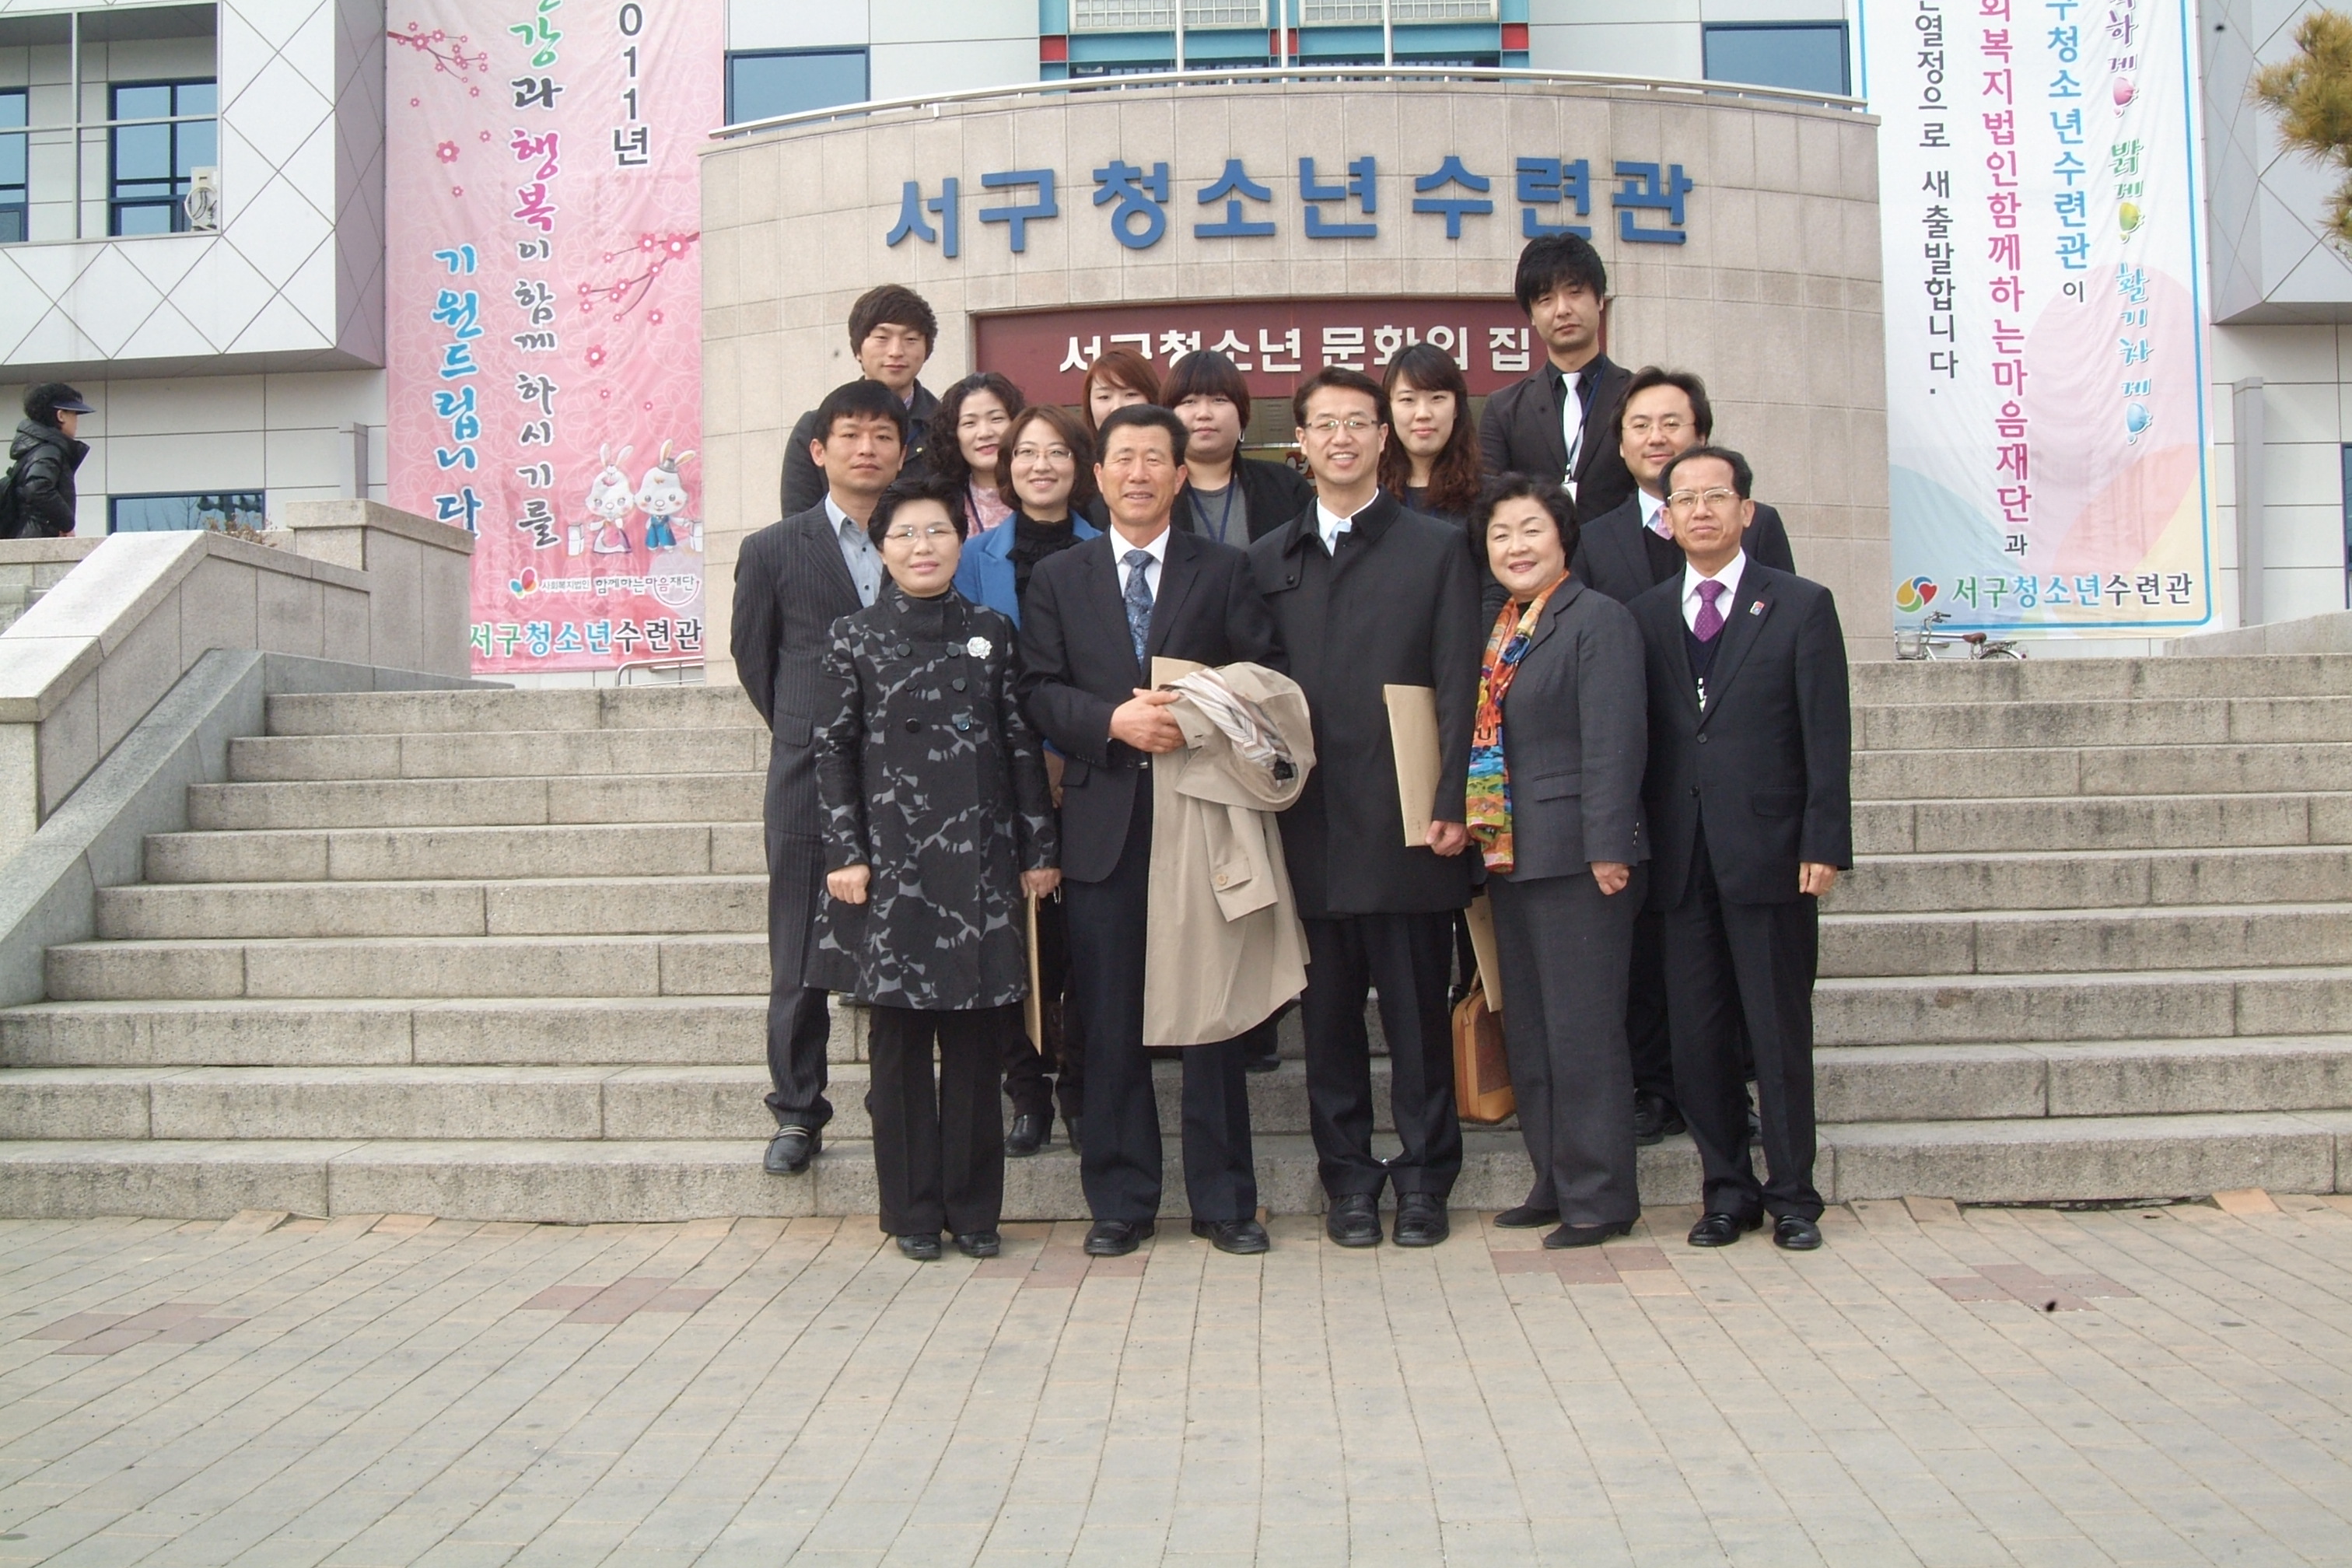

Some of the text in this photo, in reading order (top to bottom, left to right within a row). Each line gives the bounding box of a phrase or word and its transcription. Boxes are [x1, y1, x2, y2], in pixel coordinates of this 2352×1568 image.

[509, 0, 562, 108] 강과
[2105, 0, 2139, 72] 하게
[1915, 0, 1950, 148] 열정으로
[1321, 324, 1468, 371] 문화의
[1489, 327, 1530, 372] 집
[2115, 262, 2154, 397] 활기차게
[432, 245, 482, 537] 기원드립니다
[542, 579, 591, 591] 사회복지법인
[1951, 572, 2194, 609] 서구청소년수련관
[471, 618, 703, 656] 서구청소년수련관
